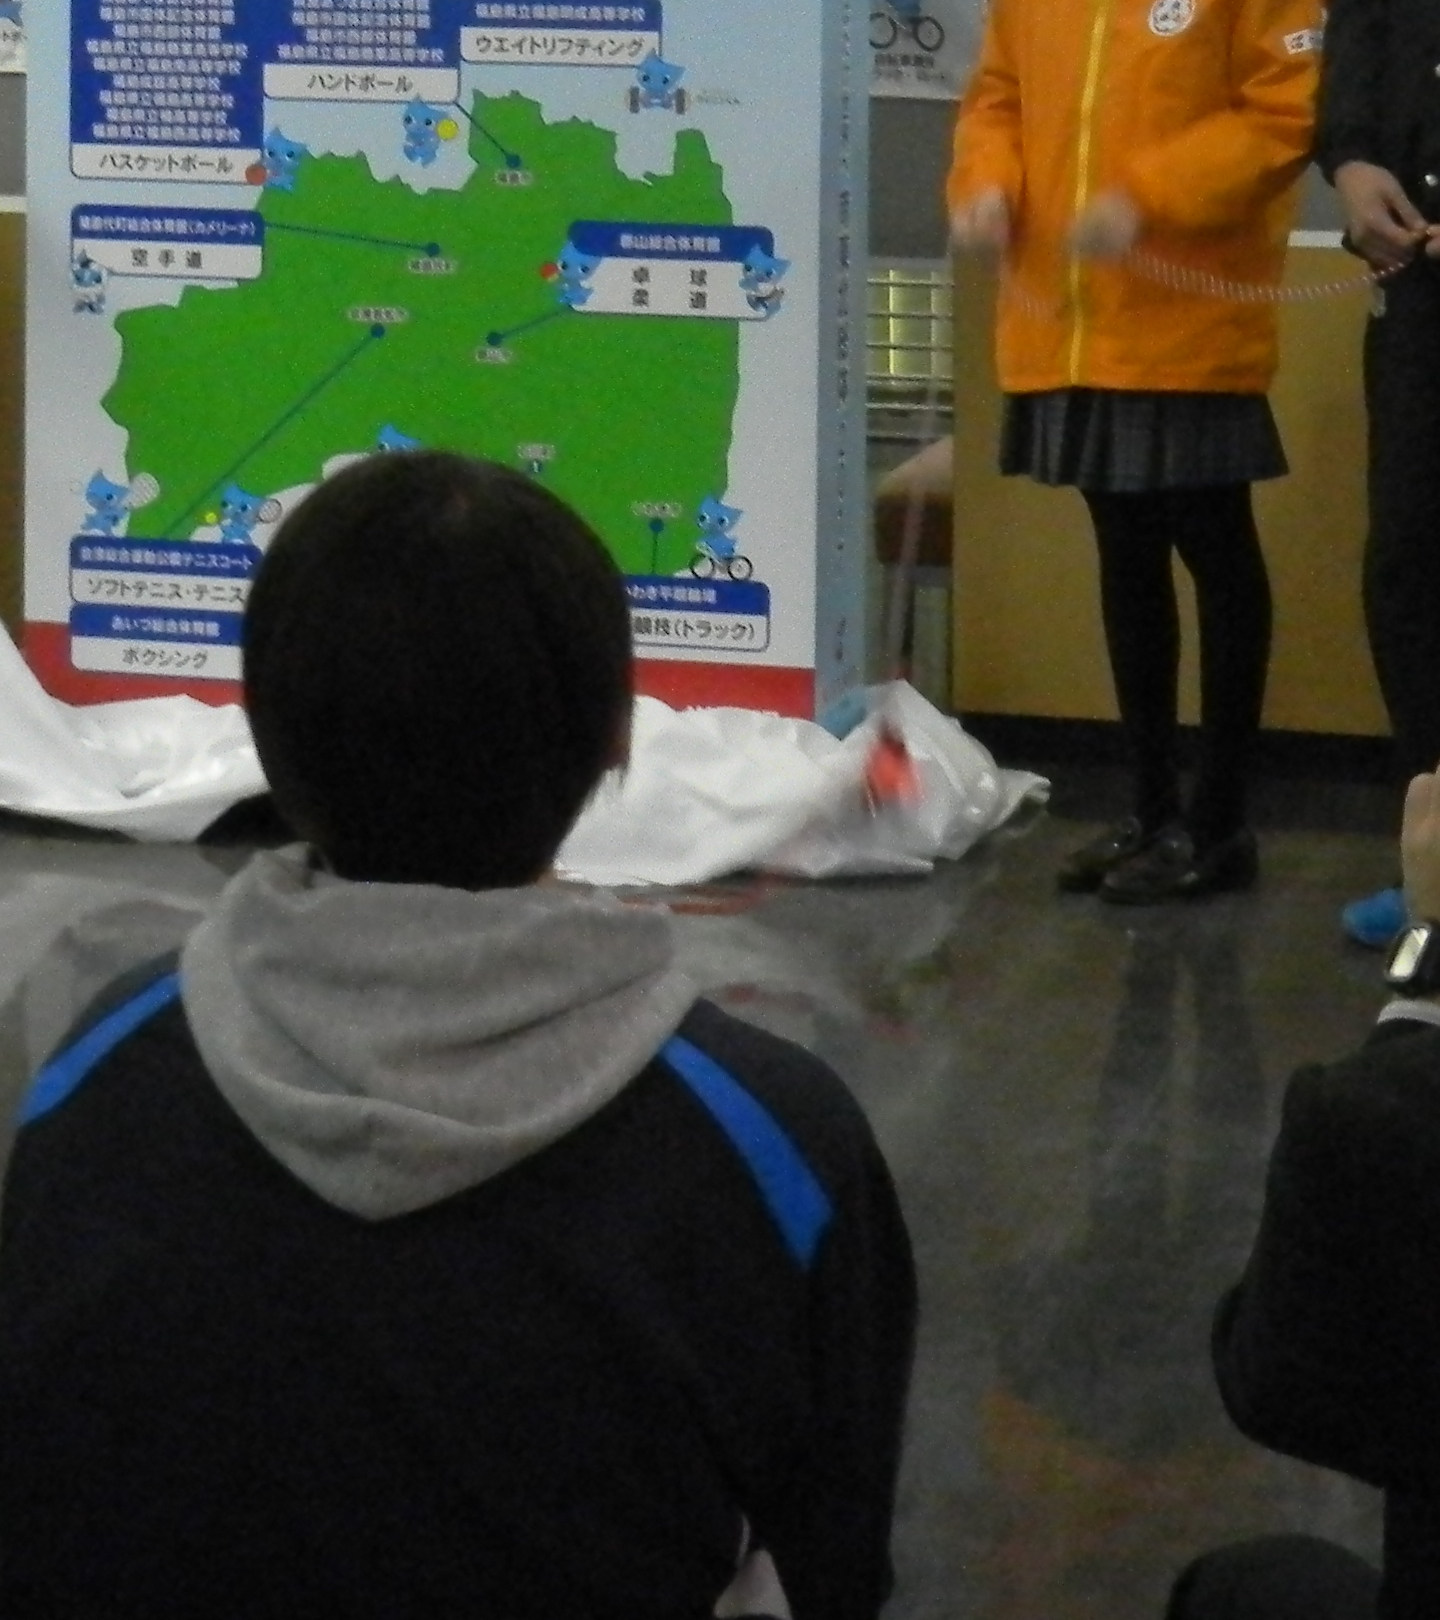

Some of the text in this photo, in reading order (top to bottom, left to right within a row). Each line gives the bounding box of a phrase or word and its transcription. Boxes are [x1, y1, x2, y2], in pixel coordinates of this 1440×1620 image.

[474, 35, 645, 58] ウエイトリフティング
[307, 72, 414, 93] ハンドボール
[100, 152, 234, 174] バスケットボール
[122, 646, 209, 670] ボクシング
